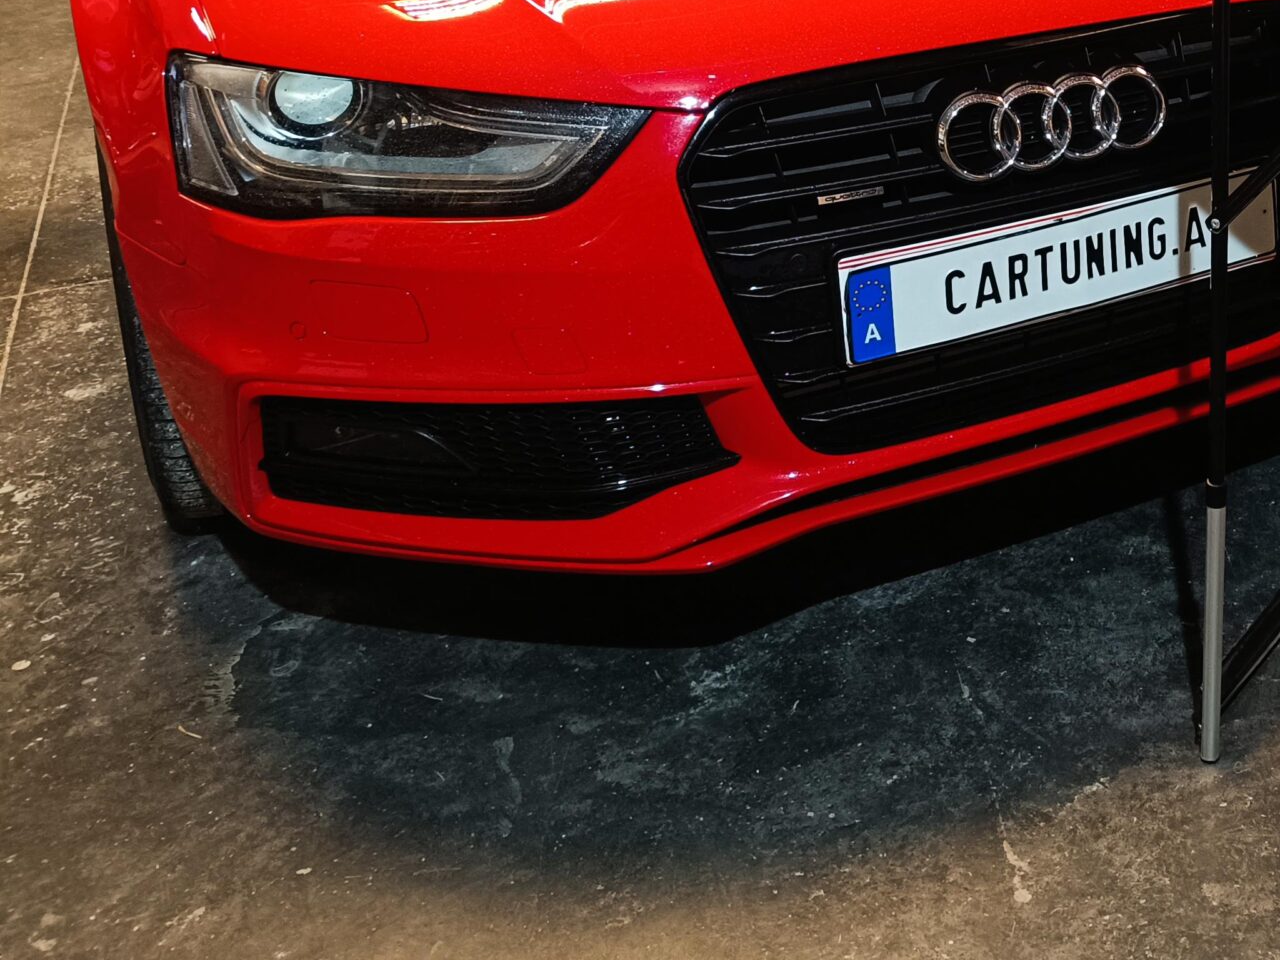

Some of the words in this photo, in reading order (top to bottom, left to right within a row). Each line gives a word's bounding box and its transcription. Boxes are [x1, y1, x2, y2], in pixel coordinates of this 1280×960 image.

[825, 189, 877, 203] quattro
[943, 206, 1209, 315] CARTUNING.A
[864, 322, 881, 345] A
